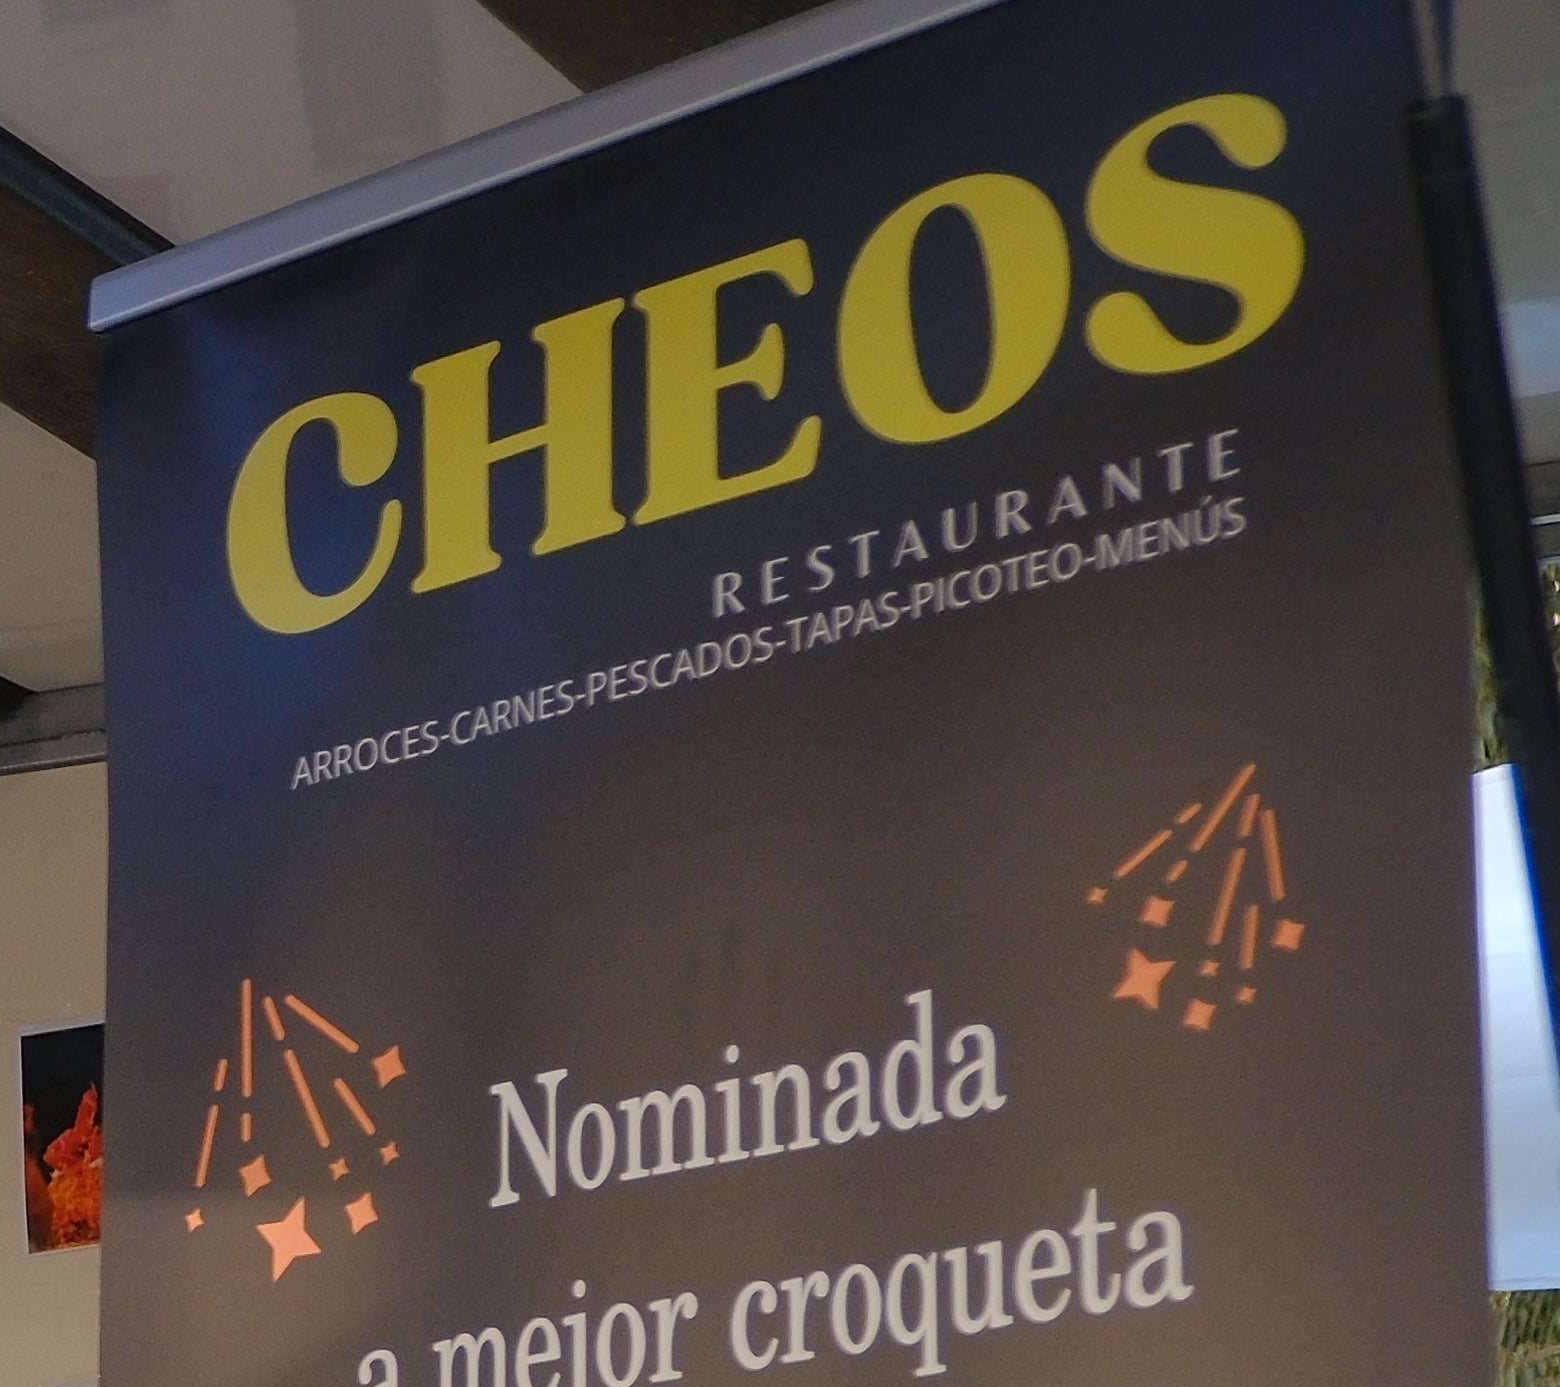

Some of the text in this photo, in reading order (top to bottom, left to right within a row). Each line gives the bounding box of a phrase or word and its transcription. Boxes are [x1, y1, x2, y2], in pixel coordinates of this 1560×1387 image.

[226, 94, 1305, 634] CHEOS
[712, 428, 1242, 618] RESTAURANTE
[290, 494, 1248, 791] ARROCES-CARNES-PESCADOS-TAPAS-PICOTEO-MENÚS
[490, 988, 1008, 1208] Nominada
[729, 1187, 1194, 1377] croqueta
